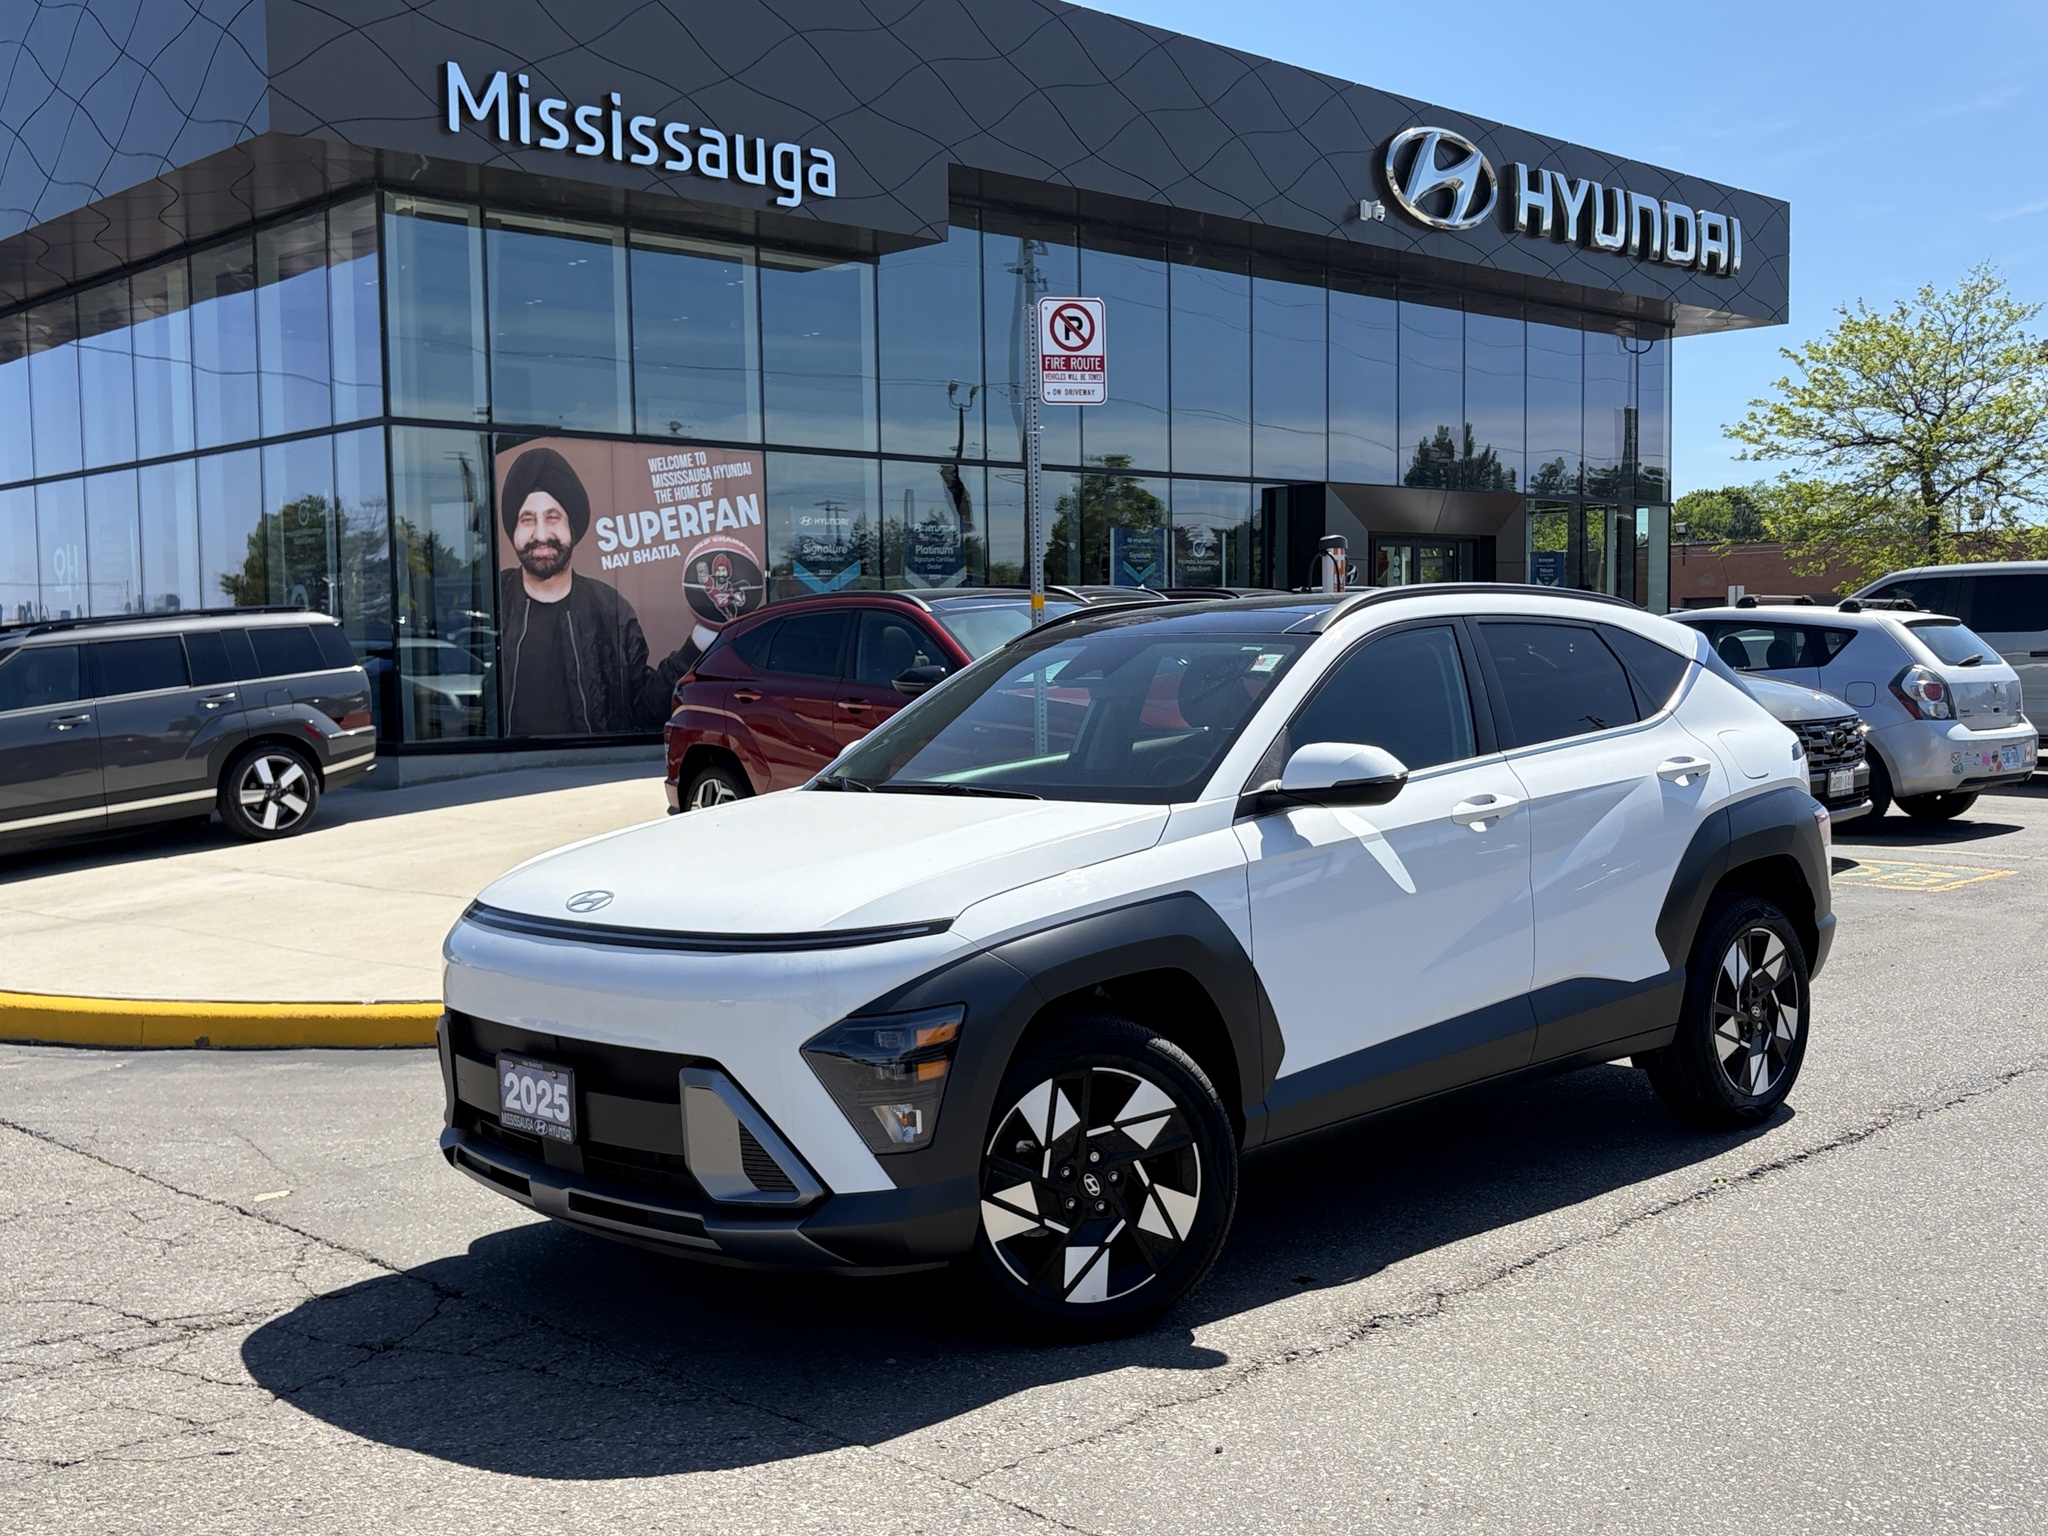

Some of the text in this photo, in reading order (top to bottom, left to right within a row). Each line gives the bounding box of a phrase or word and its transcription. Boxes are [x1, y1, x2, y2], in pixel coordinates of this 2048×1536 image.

[446, 60, 837, 208] Mississauga
[1514, 161, 1742, 278] HYUNDAI
[1045, 357, 1102, 371] FIRE ROUTE
[1045, 373, 1102, 381] VEHICLES WILL BE TOWED
[1052, 388, 1095, 396] ON DRIVEWAY
[648, 451, 707, 473] WELCOME TO
[651, 461, 752, 488] MISSISSAUGA HYUNDAI
[654, 482, 713, 504] THE HOME OF
[595, 493, 761, 552] SUPERFAN
[814, 517, 850, 526] HYUNDAI
[601, 543, 681, 571] NAV BHATIA
[802, 543, 848, 556] Signature
[915, 545, 954, 555] Platinum
[504, 1072, 570, 1122] 2025
[501, 1111, 572, 1142] MISSISSAUGA HYUNDAI
